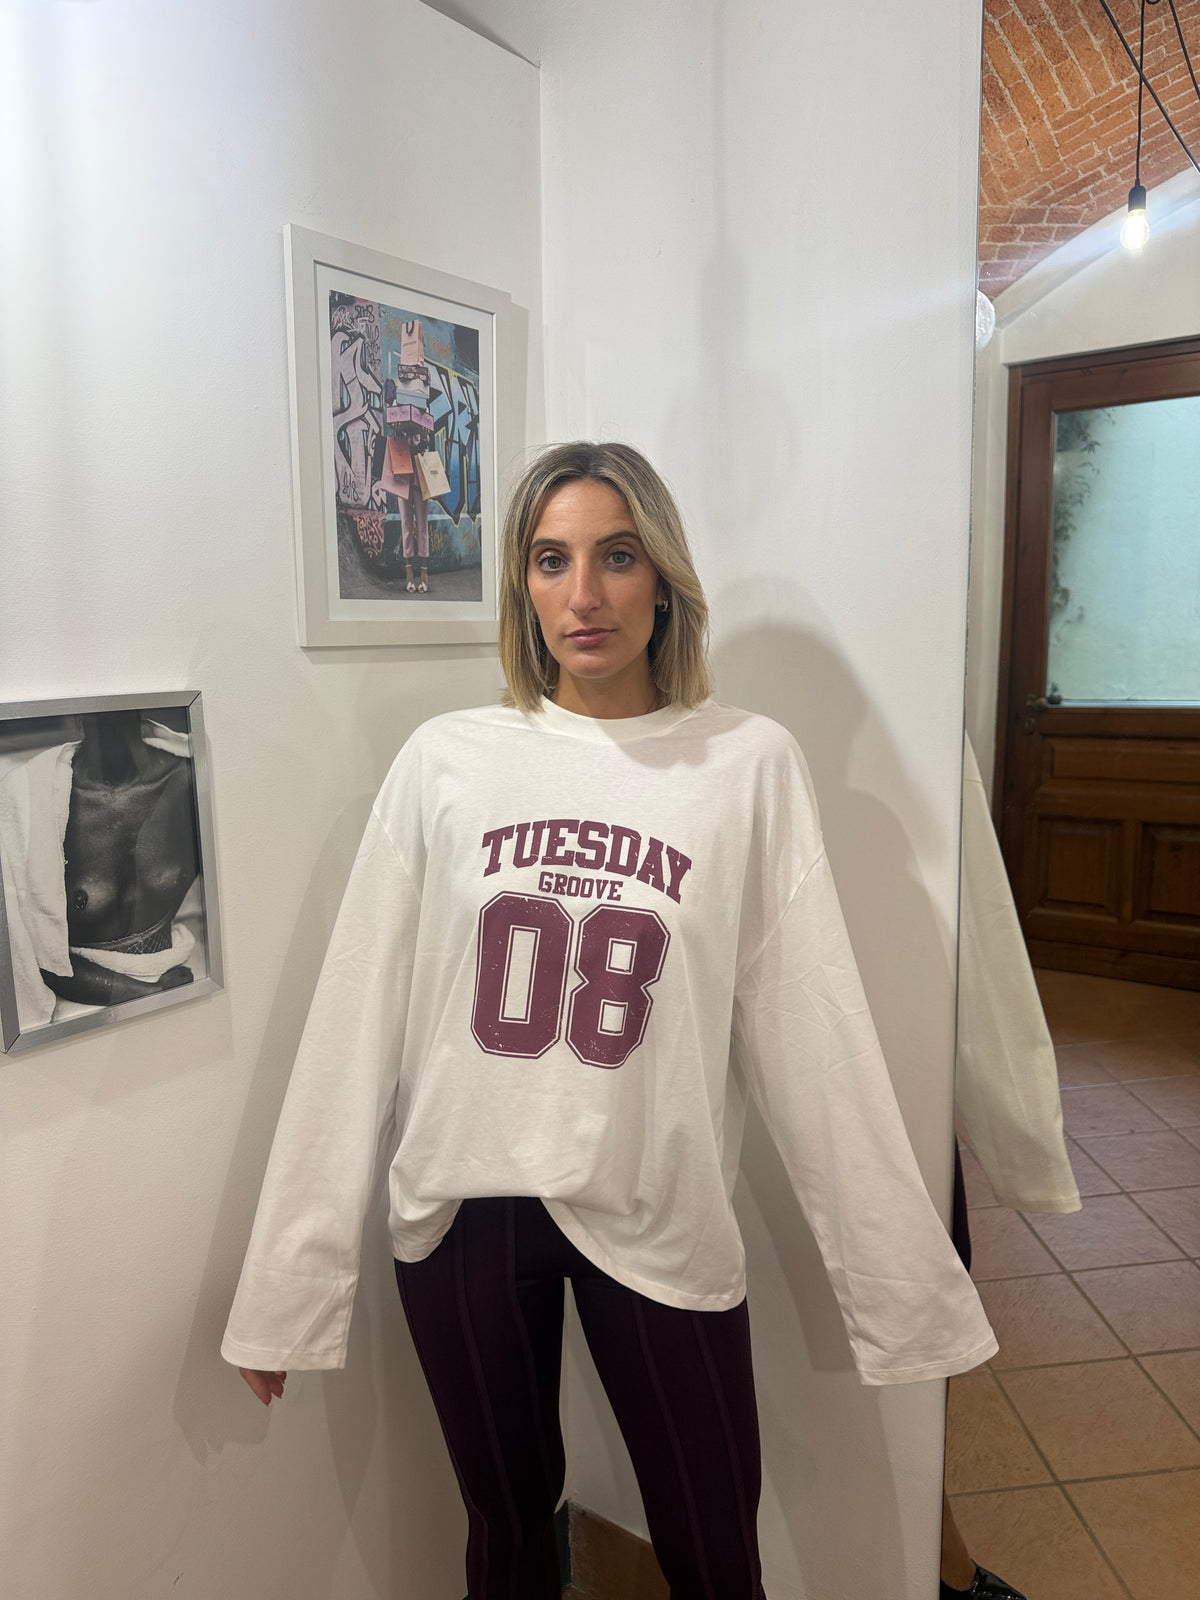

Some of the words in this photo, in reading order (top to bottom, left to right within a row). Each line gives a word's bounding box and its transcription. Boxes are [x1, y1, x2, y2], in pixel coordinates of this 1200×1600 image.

[482, 819, 692, 904] TUESDAY
[538, 871, 623, 901] GROOVE
[471, 890, 671, 1069] 08
